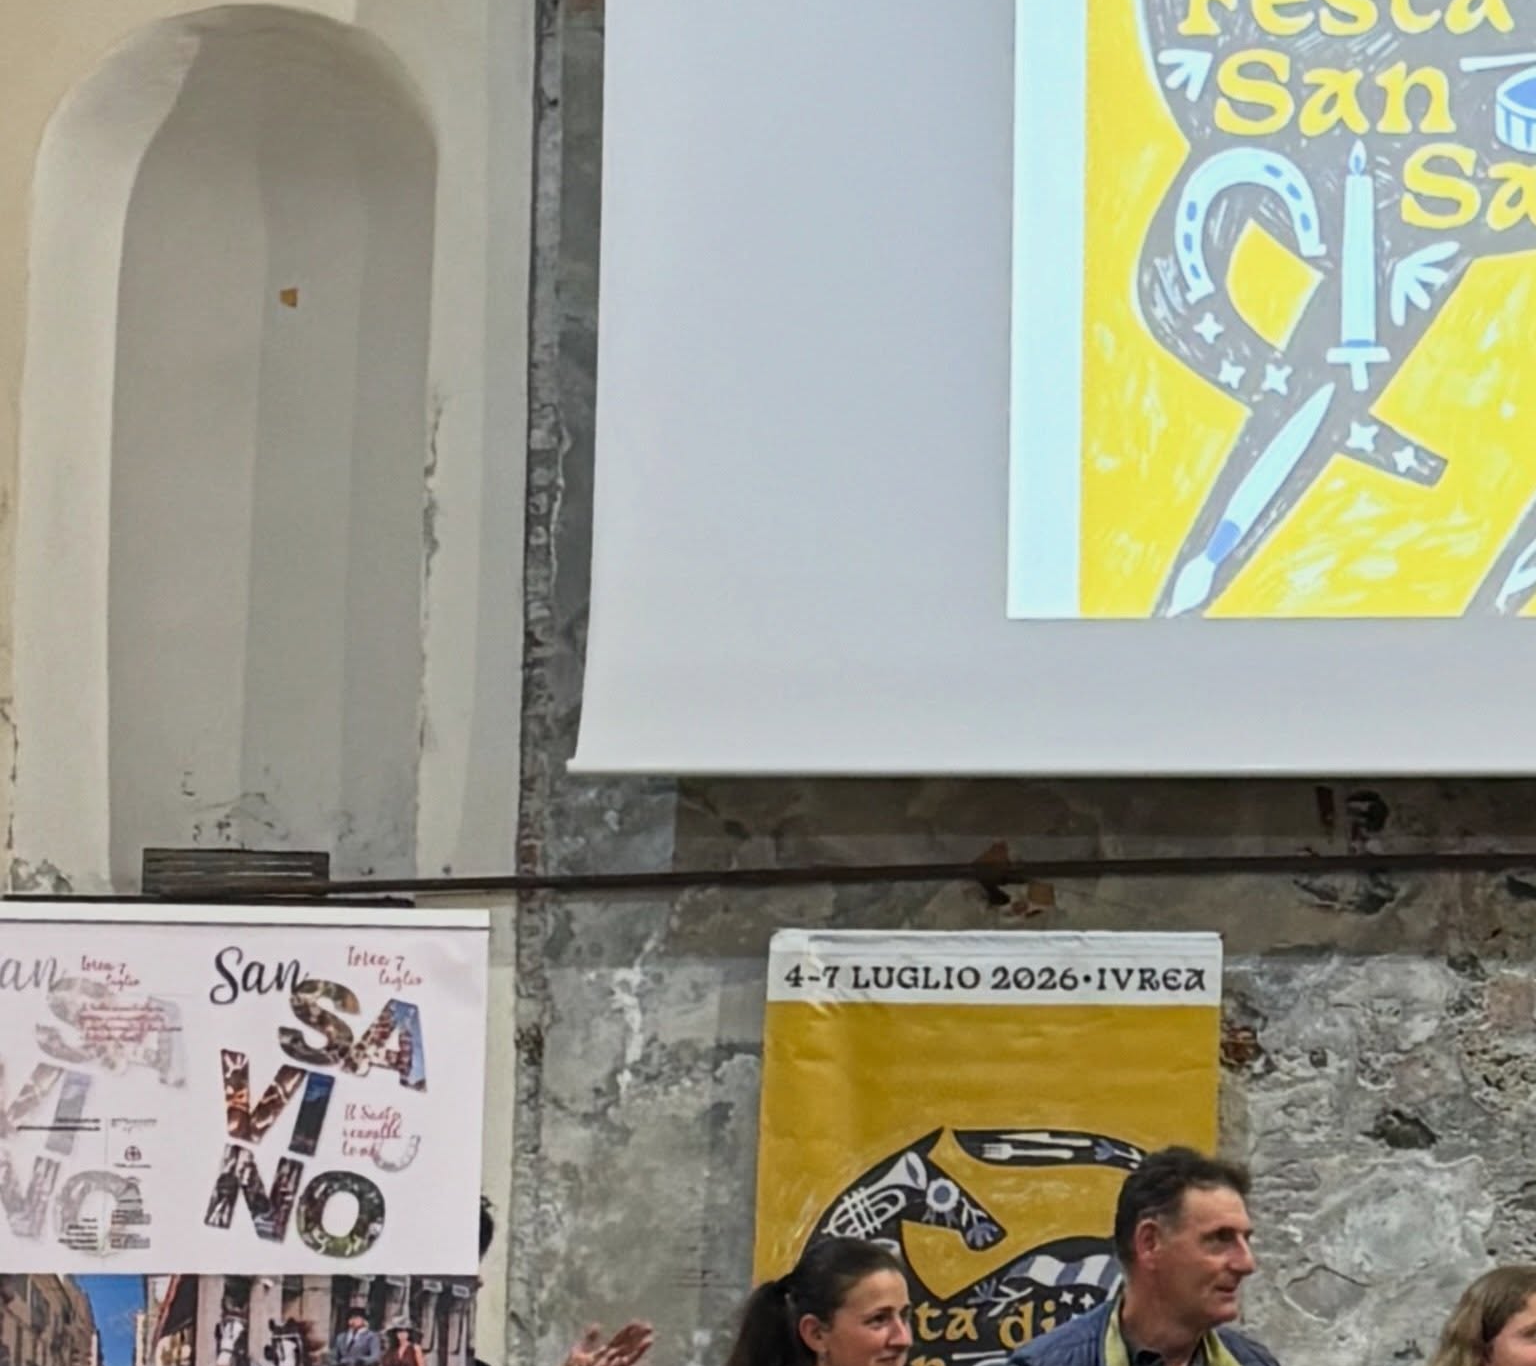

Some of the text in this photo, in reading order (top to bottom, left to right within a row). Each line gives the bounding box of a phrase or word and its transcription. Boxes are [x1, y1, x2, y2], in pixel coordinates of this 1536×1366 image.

[1214, 49, 1457, 138] San
[209, 945, 308, 1006] San
[784, 965, 841, 990] 4-7
[851, 965, 981, 992] LUGLIO
[278, 978, 428, 1092] SA
[220, 1048, 336, 1158] VI
[204, 1143, 386, 1259] NO
